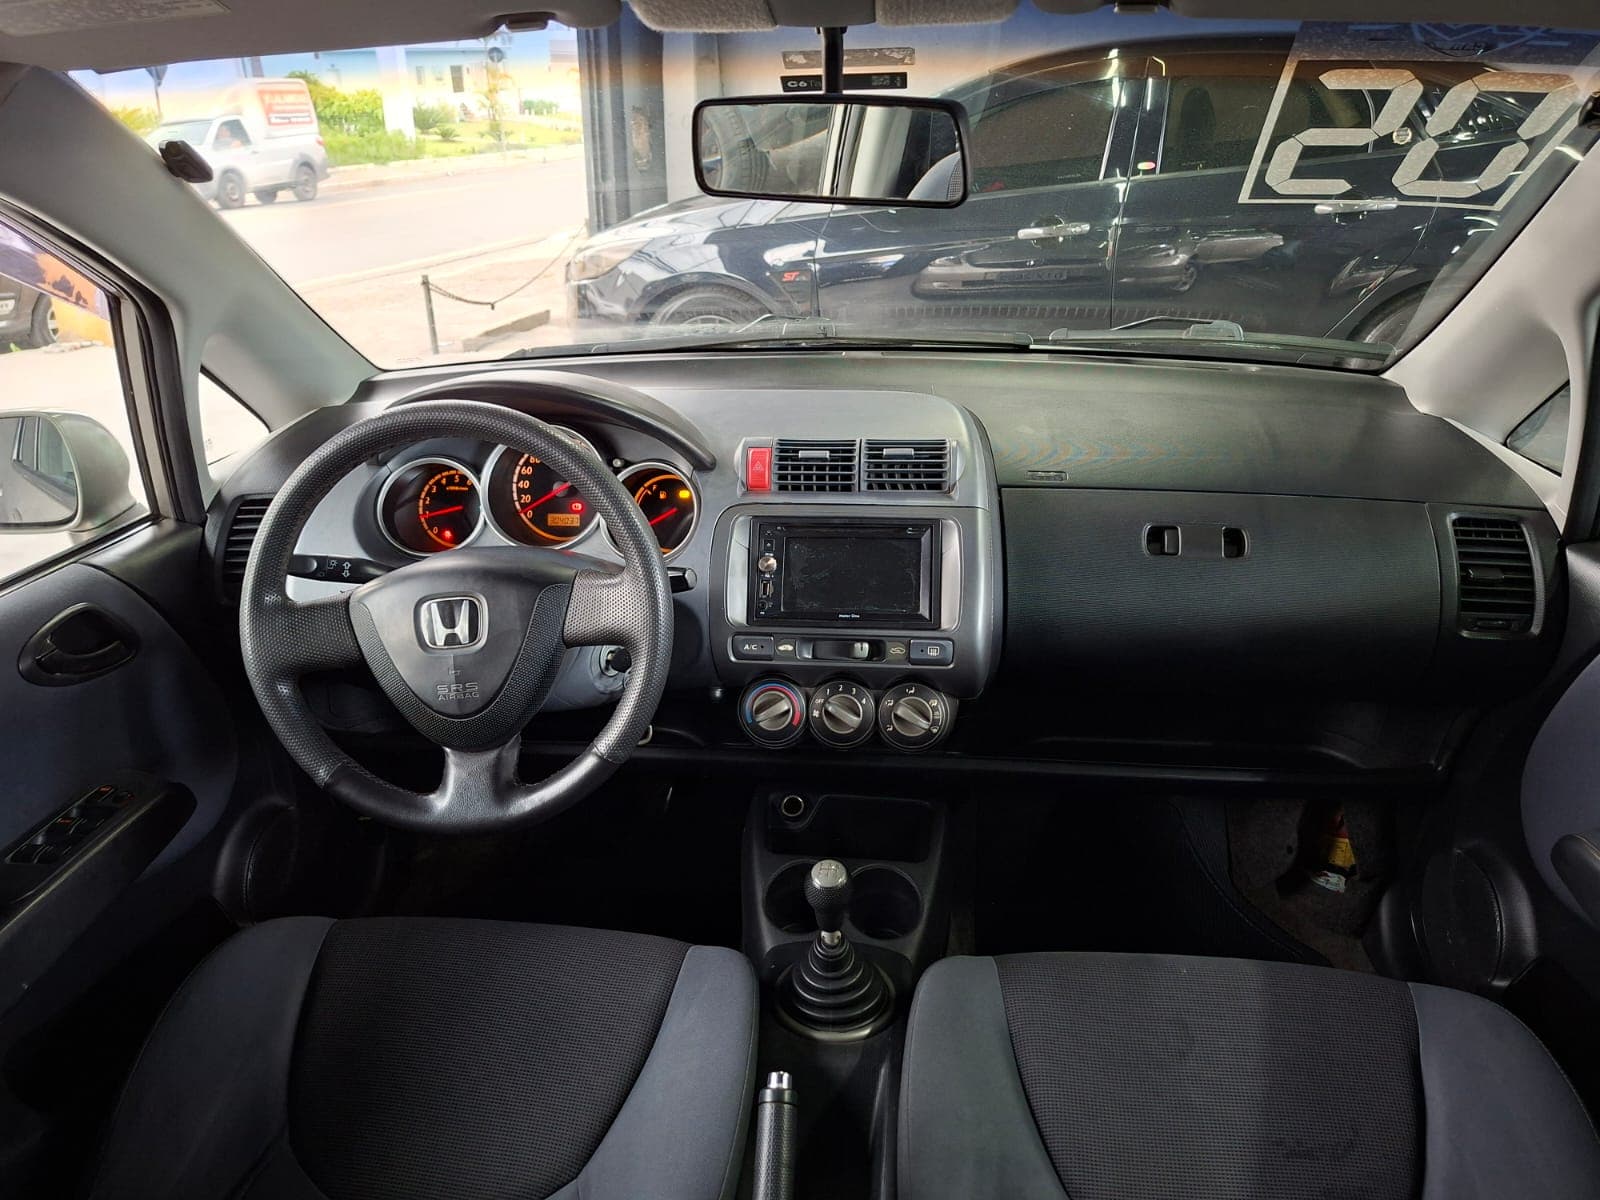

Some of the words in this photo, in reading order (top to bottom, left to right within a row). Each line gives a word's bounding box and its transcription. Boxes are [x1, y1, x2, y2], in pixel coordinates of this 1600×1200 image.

[782, 271, 800, 281] ST
[521, 466, 533, 475] 60
[518, 480, 530, 489] 40
[520, 494, 532, 503] 20
[526, 510, 533, 519] 0
[432, 526, 439, 535] 0
[743, 643, 758, 651] A/C
[436, 682, 479, 693] SRS
[438, 691, 480, 701] AIRBAG
